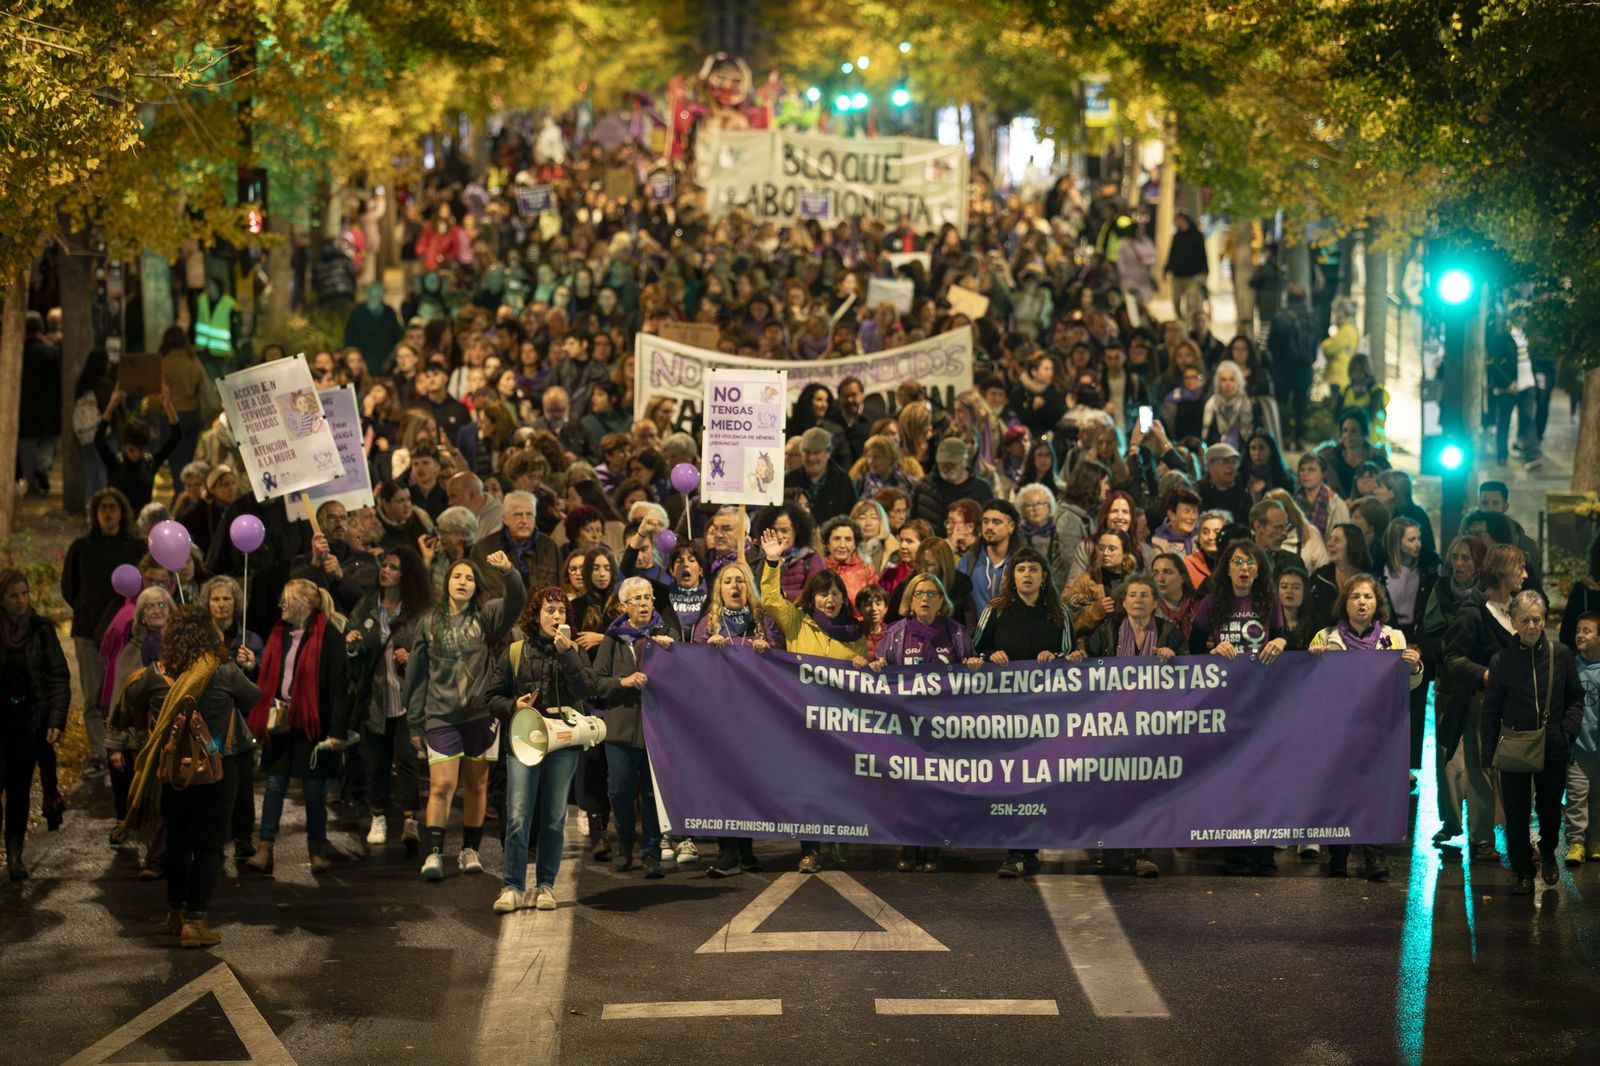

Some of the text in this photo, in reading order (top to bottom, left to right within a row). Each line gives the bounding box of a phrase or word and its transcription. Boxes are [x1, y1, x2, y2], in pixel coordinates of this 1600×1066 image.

[783, 144, 902, 185] BLOQUE
[650, 350, 703, 390] NO
[233, 386, 261, 400] ACCESO
[257, 394, 272, 406] LOS
[714, 386, 741, 402] NO
[241, 404, 278, 424] SERVICIOS
[711, 405, 753, 415] TENGAS
[711, 419, 752, 431] MIEDO
[249, 435, 260, 446] DE
[263, 455, 275, 468] LA
[274, 449, 297, 465] MUJER
[1229, 621, 1241, 632] UN
[1219, 633, 1241, 643] PASO
[800, 663, 1228, 695] CONTRA LAS VIOLENCIAS MACHISTAS:
[805, 705, 1226, 739] FIRMEZA Y SORORIDAD PARA ROMPER
[854, 753, 1183, 783] EL SILENCIO Y LA IMPUNIDAD
[990, 803, 1048, 816] 25N-2024
[684, 818, 870, 837] ESPACIO FEMINISMO UNITARIO DE GRANÁ
[1190, 827, 1351, 841] PLATAFORMA 8M/25N DE GRANADA
